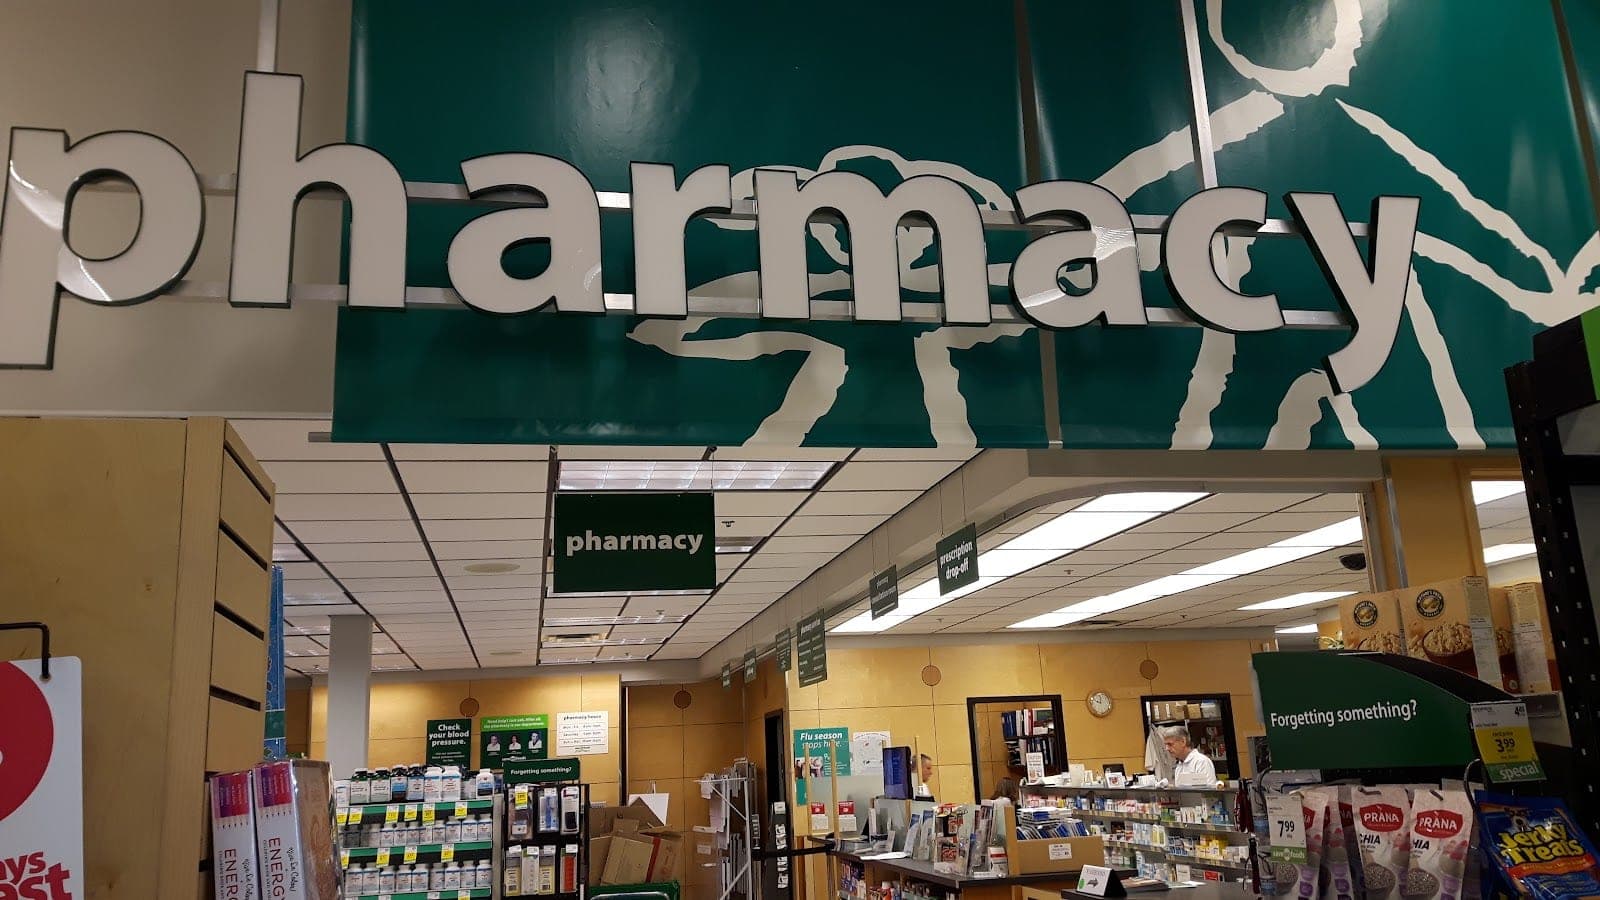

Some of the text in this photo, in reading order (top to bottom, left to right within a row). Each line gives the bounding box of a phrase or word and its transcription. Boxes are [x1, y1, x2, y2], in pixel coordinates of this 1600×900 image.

[0, 70, 1420, 395] pharmacy
[566, 529, 704, 557] pharmacy
[940, 541, 973, 568] prescription
[945, 557, 969, 580] drop-off
[1270, 699, 1418, 730] Forgetting something?
[429, 730, 470, 741] your blood
[437, 723, 461, 732] Check
[800, 732, 843, 741] Flu season
[432, 739, 467, 748] pressure.
[510, 766, 572, 777] Forgetting something?
[1499, 761, 1540, 781] special
[1496, 823, 1568, 849] Jerky
[1499, 838, 1586, 864] Treats
[224, 848, 239, 900] ENER
